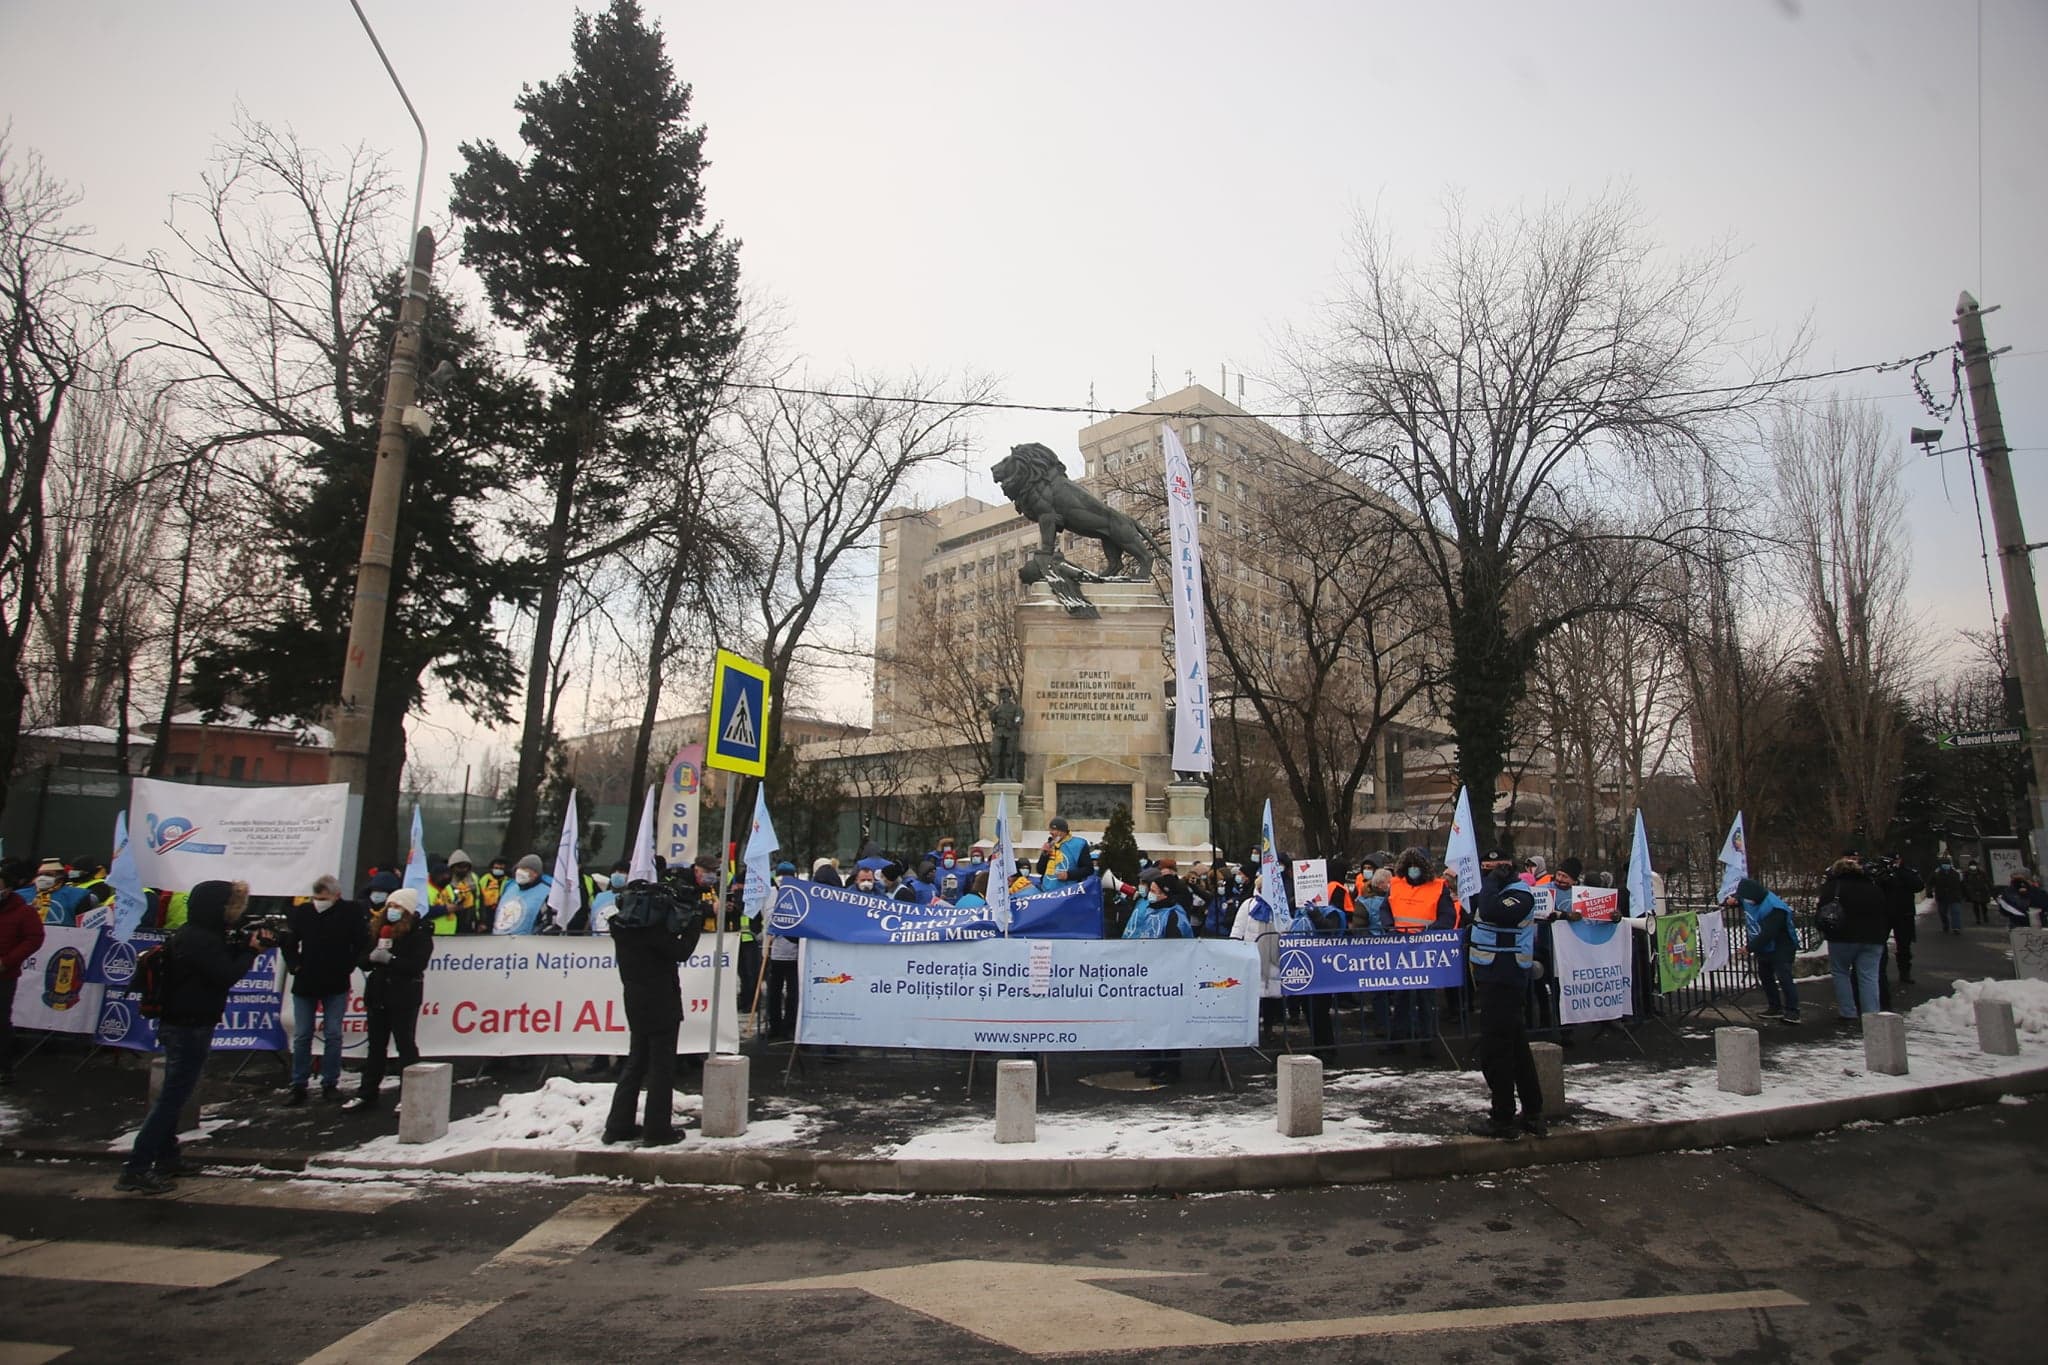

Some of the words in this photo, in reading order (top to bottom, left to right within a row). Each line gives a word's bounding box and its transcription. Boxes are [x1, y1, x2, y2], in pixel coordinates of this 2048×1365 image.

[1957, 733, 1991, 745] Bulevardul
[671, 803, 688, 868] SNP
[810, 886, 921, 916] CONFEDERAȚIA
[924, 906, 993, 918] NAȚIONA
[1010, 883, 1086, 903] NDICALĂ
[1585, 895, 1612, 907] RESPECT
[889, 929, 936, 943] Filiala
[1278, 937, 1348, 948] ONFEDERATIA
[1350, 935, 1407, 946] NATIONALA
[1408, 932, 1460, 944] SINDICALA
[249, 953, 278, 973] FA
[430, 953, 529, 979] nfederația
[536, 952, 617, 979] Naționa
[1321, 952, 1391, 972] “Cartel
[1394, 948, 1460, 970] ALFA”
[907, 960, 977, 980] Federația
[982, 962, 1075, 979] Sindiclor
[1079, 963, 1149, 982] Naționale
[1285, 966, 1306, 976] alfa
[1572, 964, 1623, 981] FEDERATI
[870, 979, 892, 994] ale
[897, 980, 975, 1000] Polițiștilor
[979, 983, 992, 1002] și
[1098, 983, 1184, 998] Contractual
[1282, 977, 1308, 985] CARTEL
[1359, 977, 1400, 987] FILIALA
[1401, 975, 1429, 986] CLUJ
[1563, 976, 1631, 997] SINDICATER
[1572, 997, 1590, 1011] DIN
[1593, 992, 1625, 1008] COME
[452, 1000, 562, 1034] Cartel
[573, 1000, 626, 1033] AL
[974, 1031, 1077, 1043] WWW.SNPPC.RO
